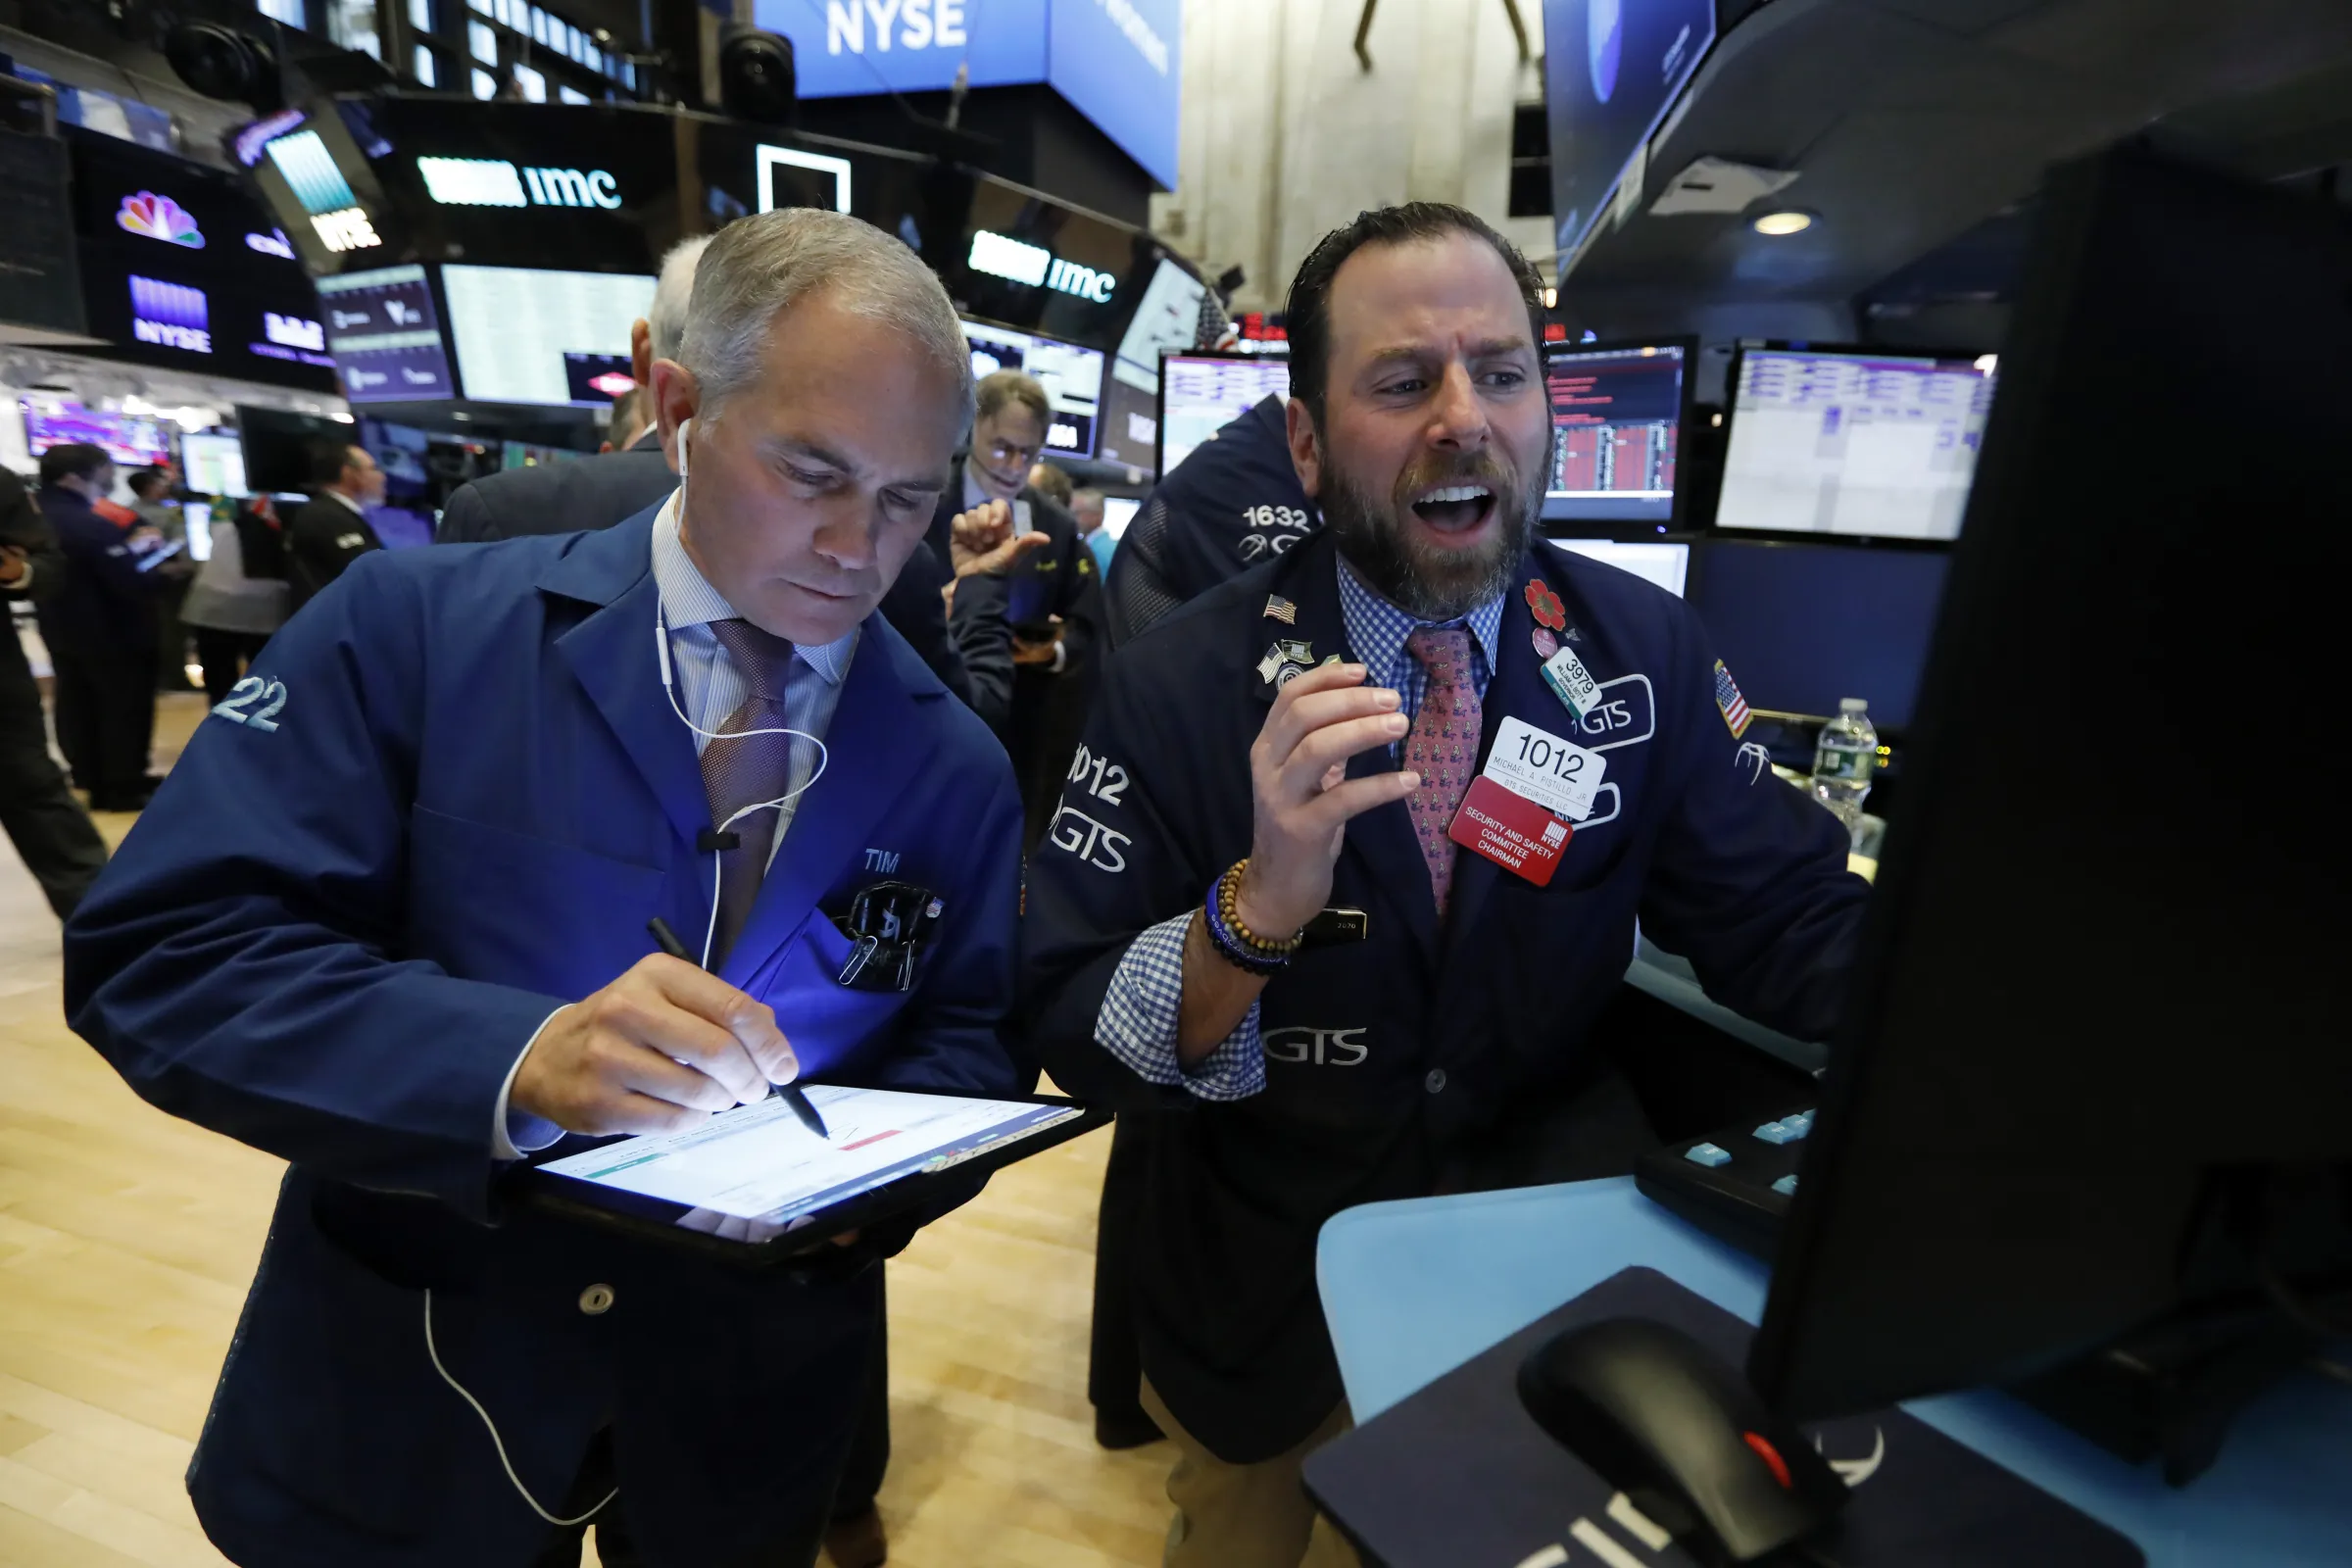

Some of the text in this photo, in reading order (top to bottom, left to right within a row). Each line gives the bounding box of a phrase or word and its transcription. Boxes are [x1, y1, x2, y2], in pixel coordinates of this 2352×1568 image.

[827, 0, 966, 55] NYSE
[133, 318, 213, 353] NYSE
[1243, 505, 1311, 532] 1632
[1566, 659, 1593, 694] 3979
[211, 676, 287, 733] 22
[1581, 700, 1632, 734] GTS
[1519, 734, 1584, 783] 1012
[1493, 756, 1526, 775] MICHAEL
[1540, 776, 1572, 795] PISTILLO
[1576, 791, 1587, 801] JR
[1503, 778, 1568, 810] GTS SECURITIES LLC
[1051, 807, 1132, 872] GTS
[1465, 807, 1554, 859] SECURITY AND SAFETY
[1482, 828, 1529, 859] COMMITTEE
[1541, 835, 1561, 850] NYSE
[865, 848, 900, 873] TIM
[1478, 840, 1522, 868] CHAIRMAN
[1262, 1026, 1368, 1066] GTS
